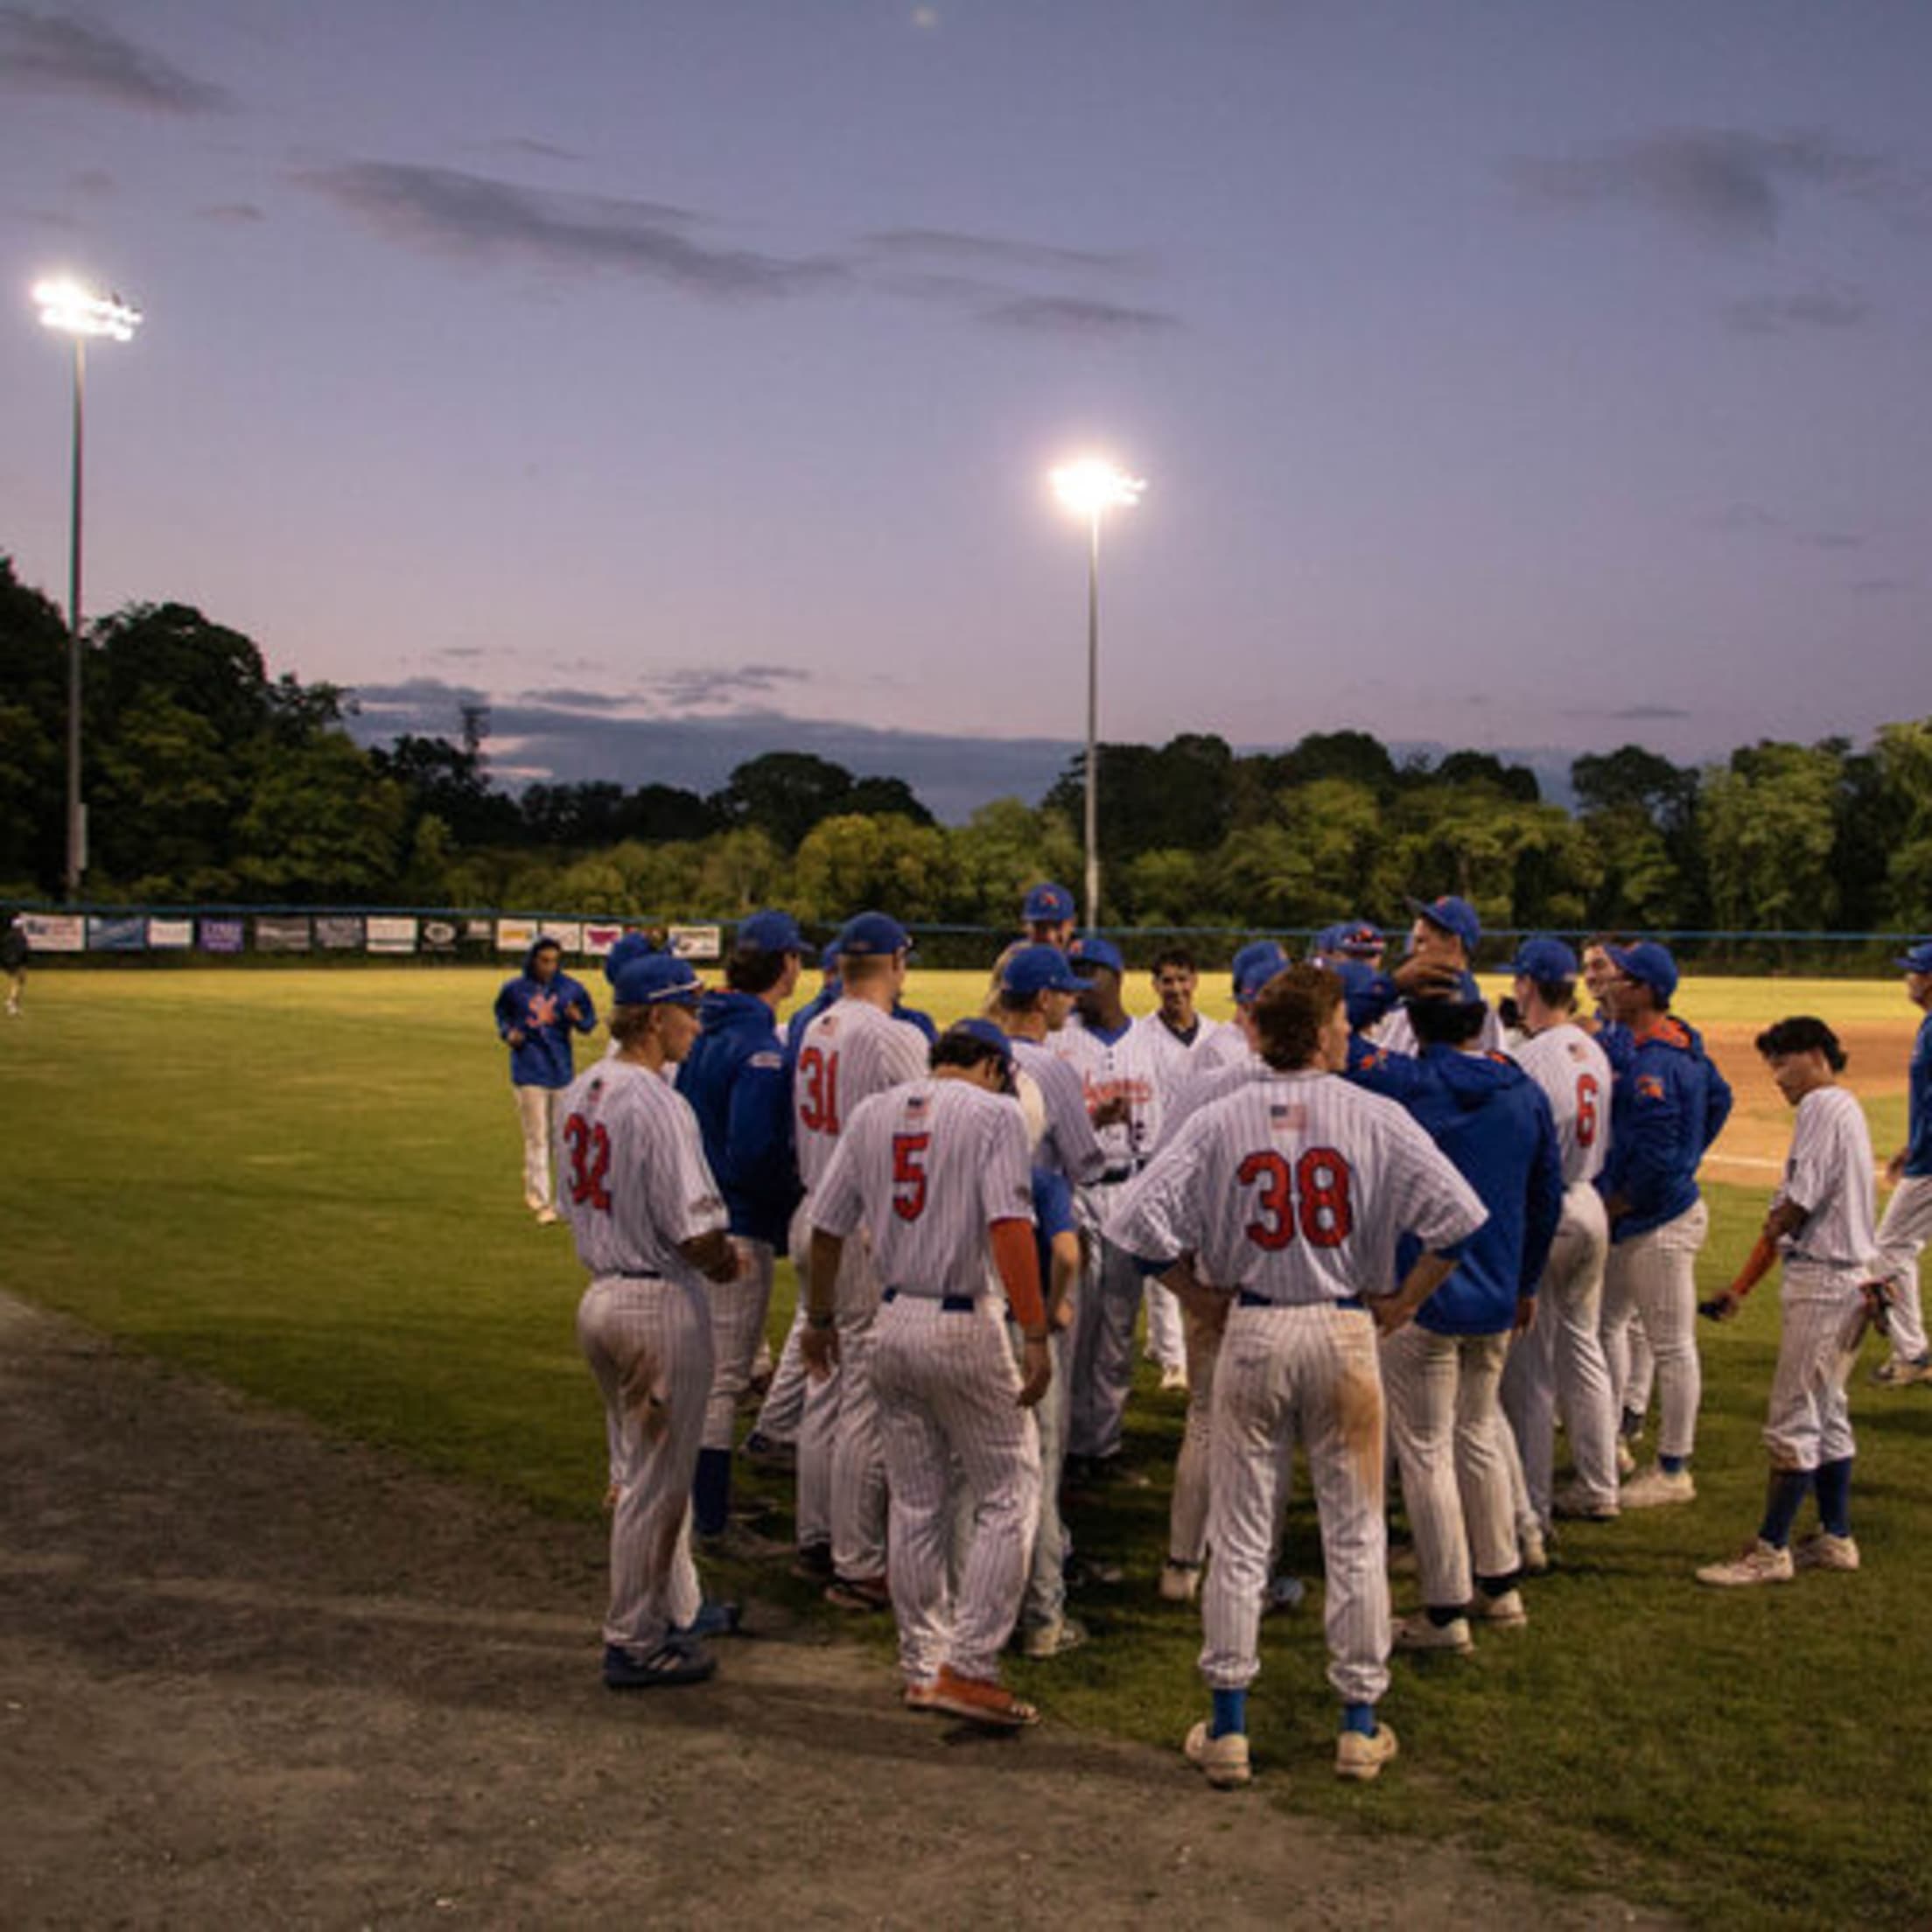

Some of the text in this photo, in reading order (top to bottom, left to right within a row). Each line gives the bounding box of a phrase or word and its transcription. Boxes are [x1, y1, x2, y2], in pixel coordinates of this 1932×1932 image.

[798, 1046, 840, 1136] 31
[1576, 1073, 1598, 1147] 6
[564, 1113, 612, 1216] 32
[892, 1131, 931, 1222] 5
[1236, 1147, 1354, 1251] 38
